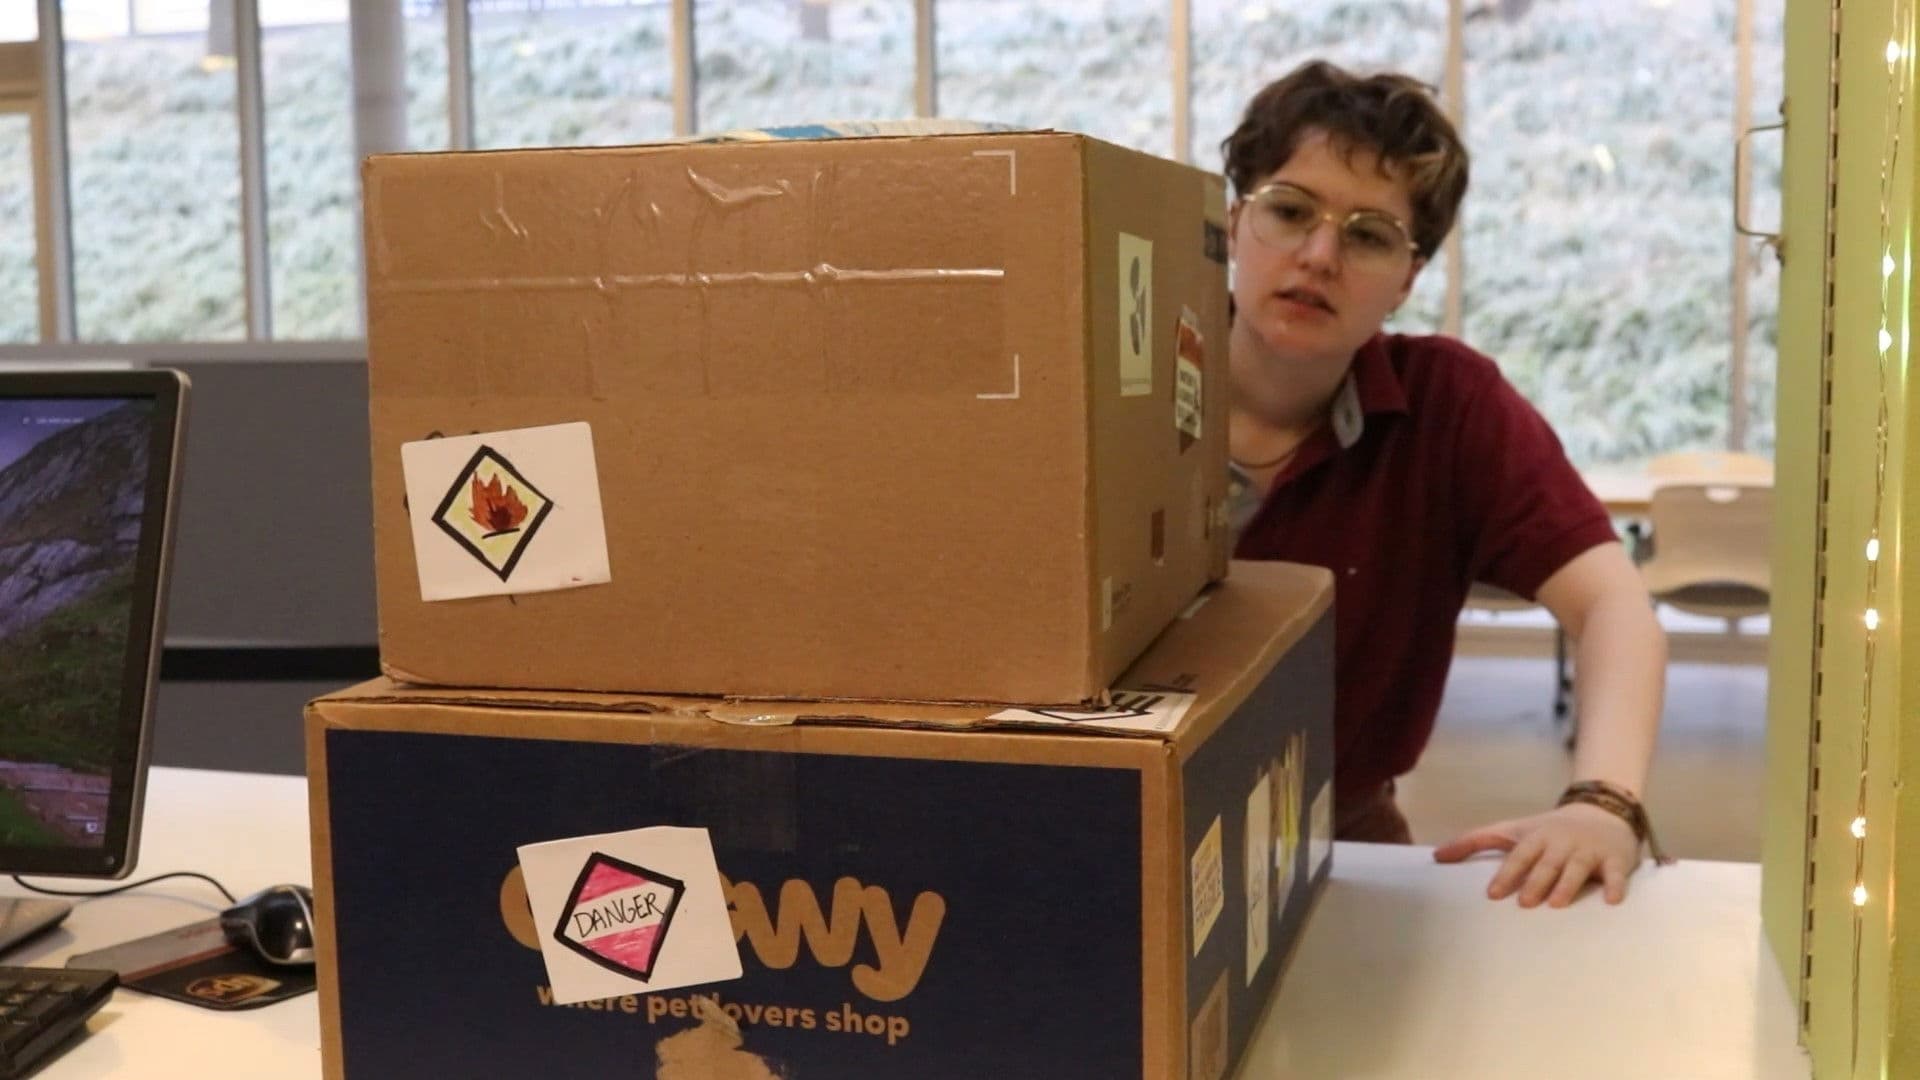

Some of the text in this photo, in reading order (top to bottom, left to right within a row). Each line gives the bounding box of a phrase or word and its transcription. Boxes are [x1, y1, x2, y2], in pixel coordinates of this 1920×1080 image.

[574, 892, 665, 938] DANGER
[646, 994, 708, 1024] pet
[711, 992, 817, 1030] overs
[825, 1002, 910, 1046] shop
